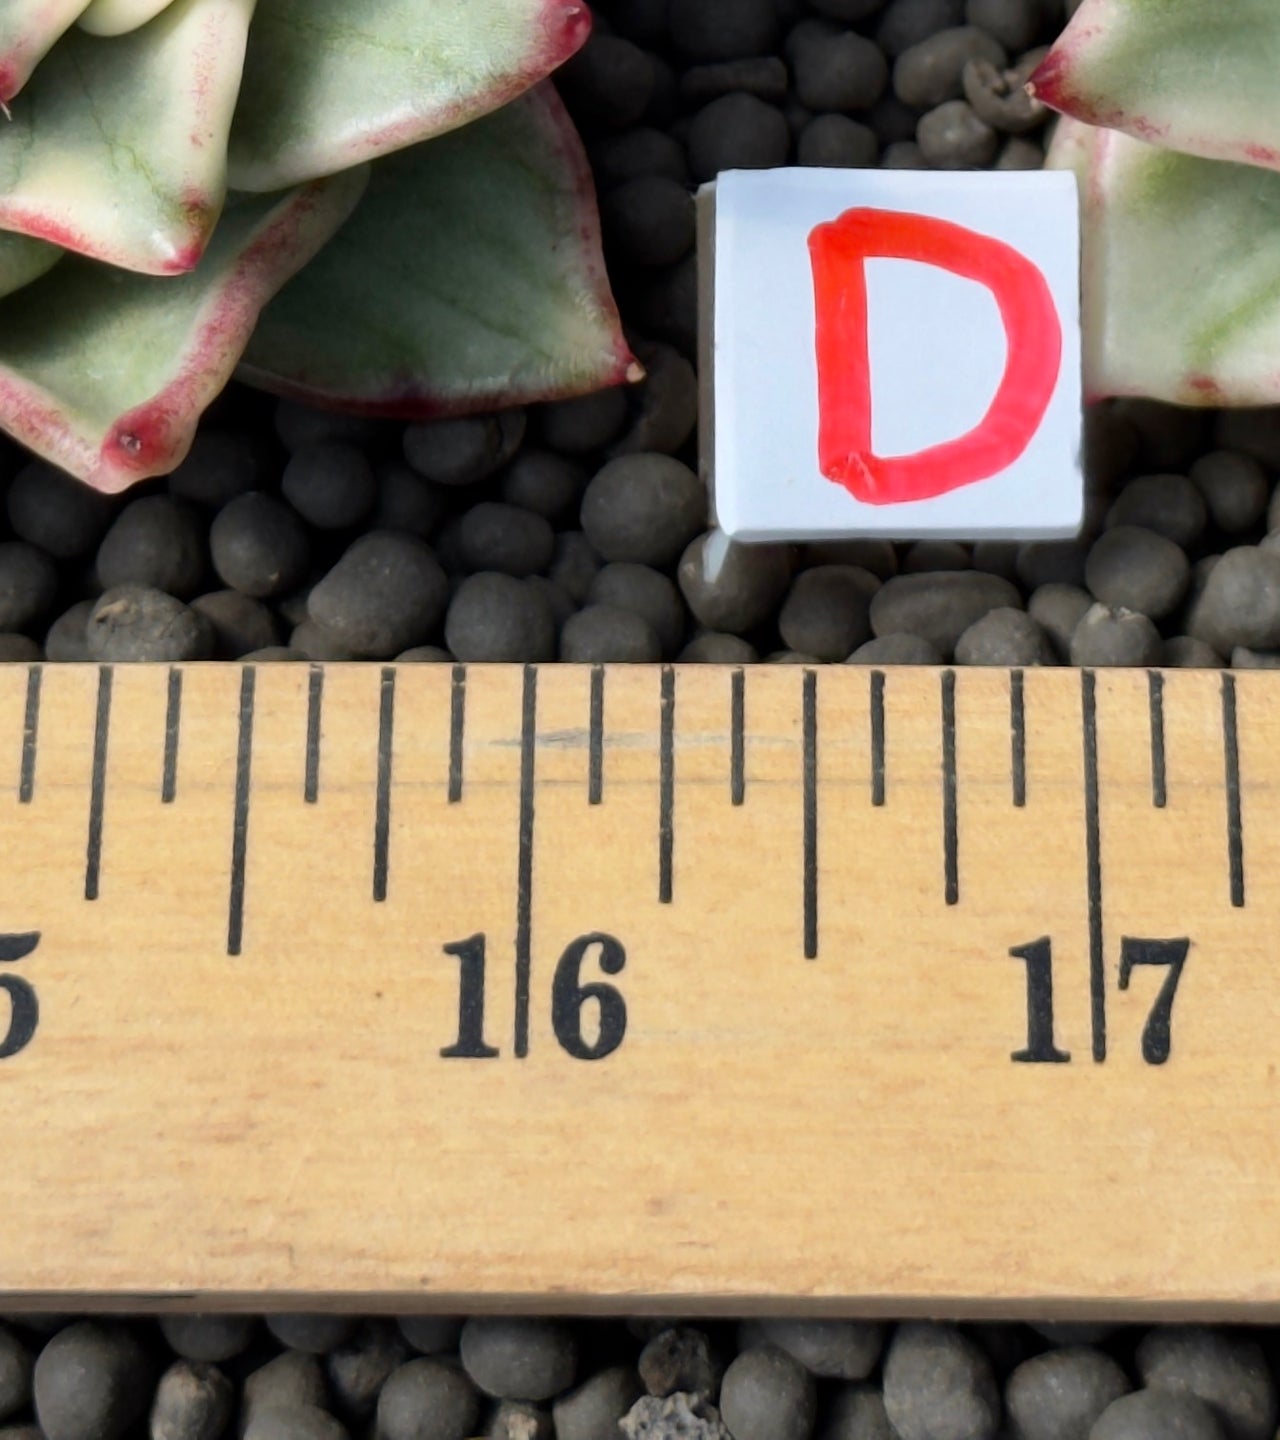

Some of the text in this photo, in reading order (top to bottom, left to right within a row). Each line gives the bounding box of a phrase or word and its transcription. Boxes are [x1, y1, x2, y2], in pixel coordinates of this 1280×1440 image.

[807, 207, 1064, 506] D
[439, 932, 627, 1061] 16
[1009, 936, 1191, 1066] 17
